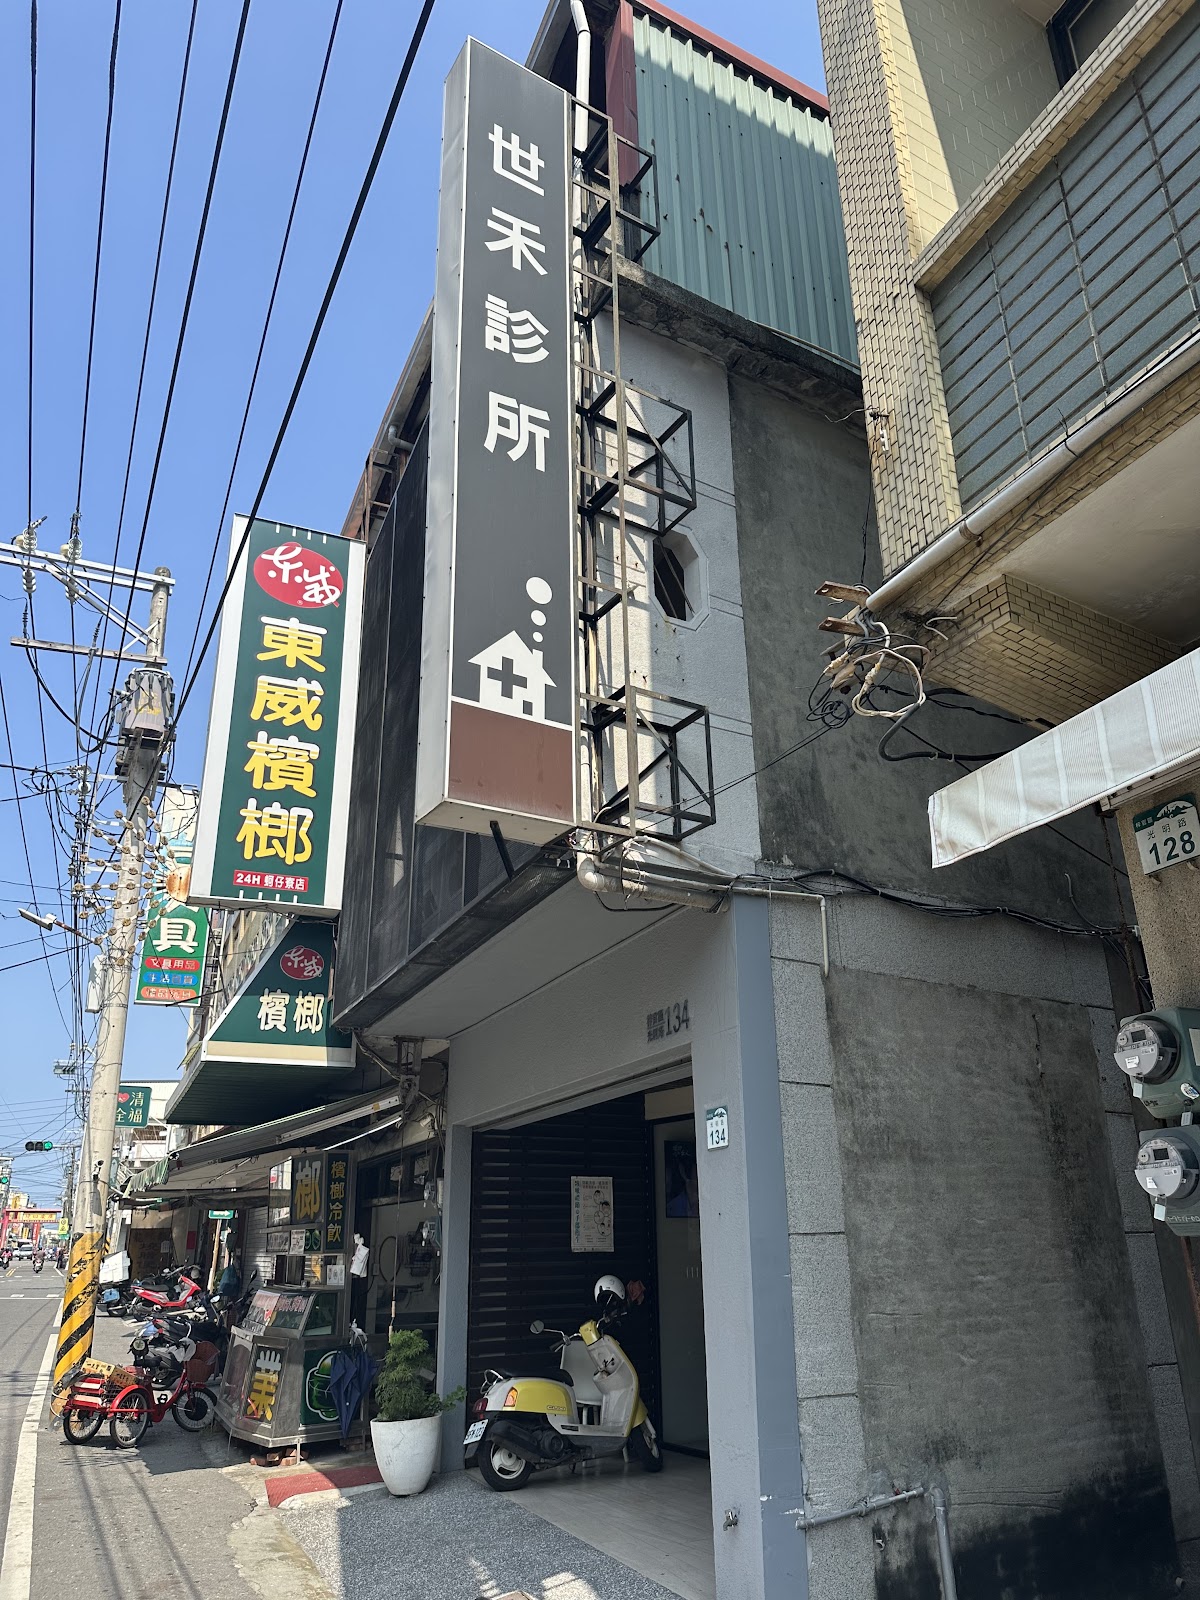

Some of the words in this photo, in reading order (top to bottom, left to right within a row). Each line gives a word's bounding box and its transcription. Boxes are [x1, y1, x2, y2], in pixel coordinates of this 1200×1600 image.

[483, 123, 550, 472] 世禾診所
[235, 616, 329, 866] 東威檳榔
[1147, 817, 1187, 841] 光明路
[1149, 830, 1196, 866] 128
[235, 872, 262, 886] 24H
[263, 875, 305, 890] 蚵仔寮店
[257, 987, 325, 1035] 檳榔
[665, 998, 690, 1036] 134
[709, 1128, 726, 1146] 134
[294, 1159, 322, 1220] 榔
[327, 1160, 347, 1243] 檳榔冷飲
